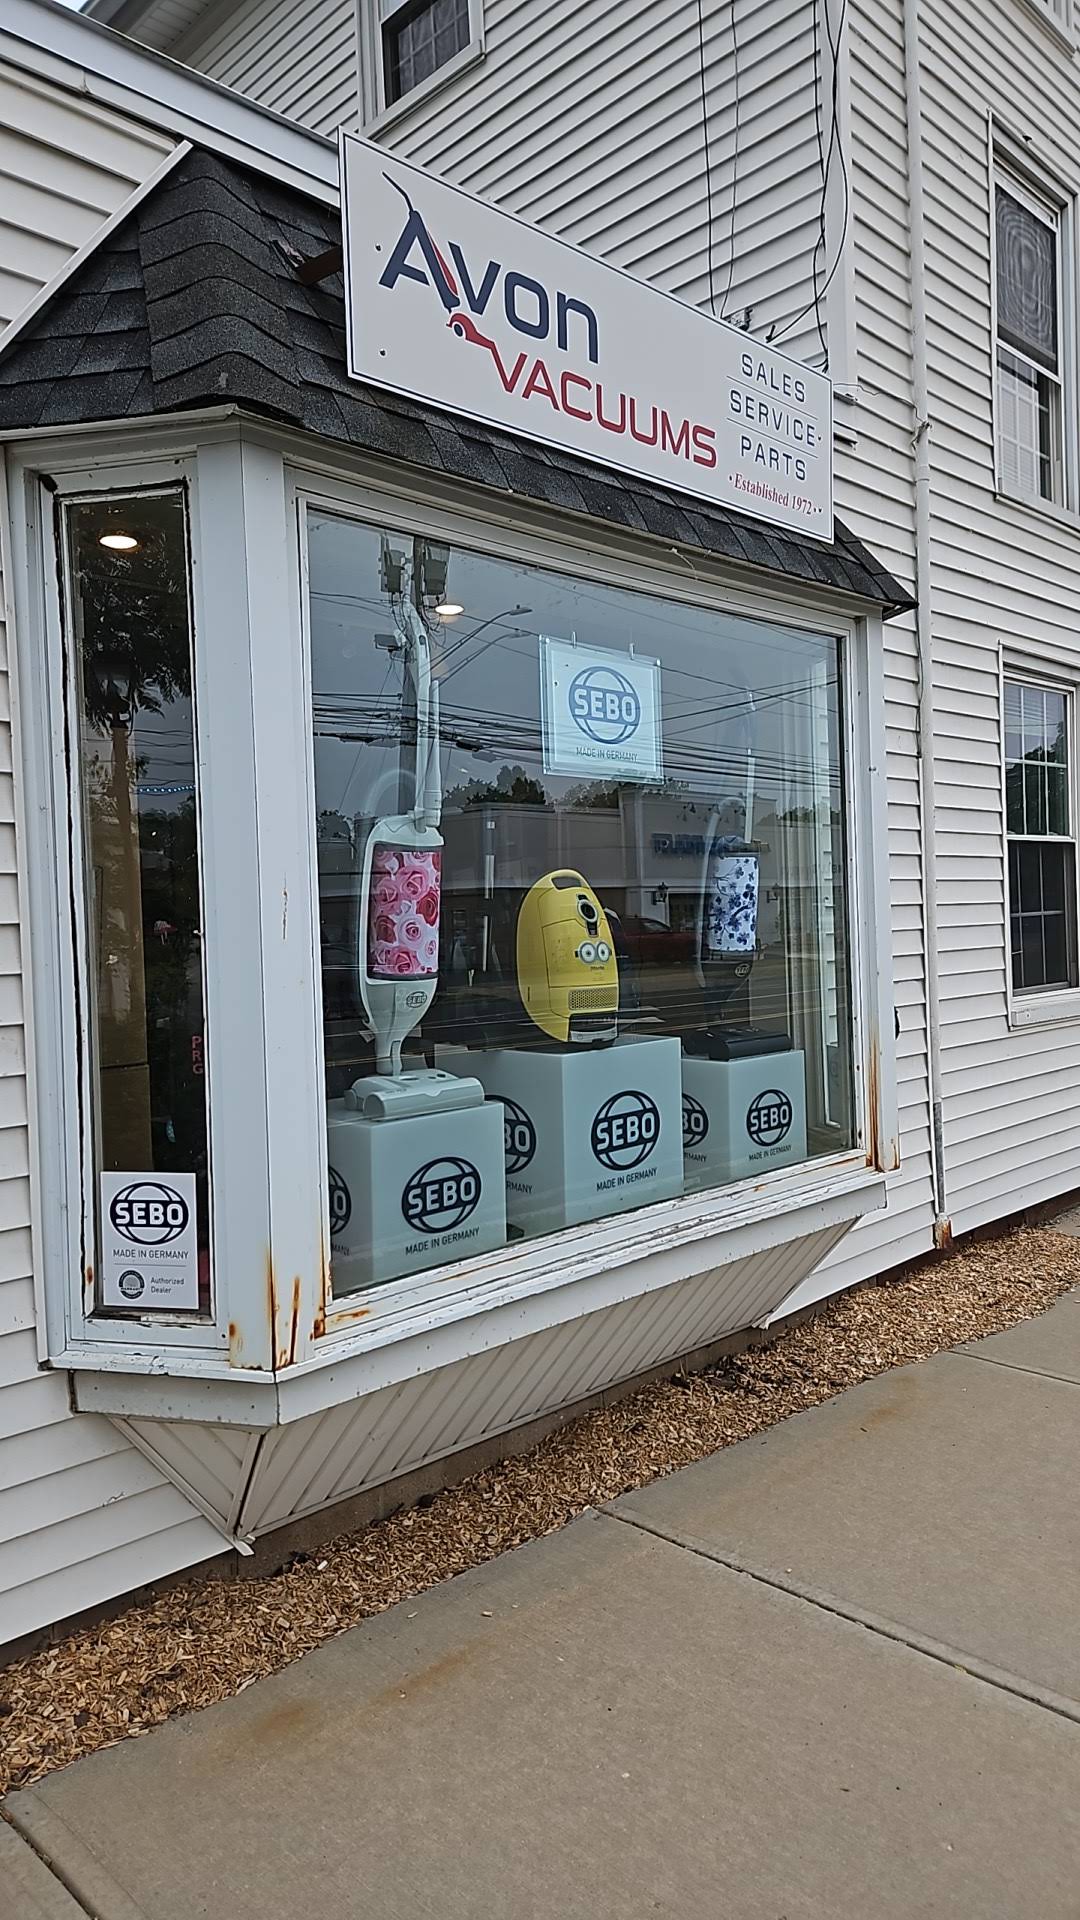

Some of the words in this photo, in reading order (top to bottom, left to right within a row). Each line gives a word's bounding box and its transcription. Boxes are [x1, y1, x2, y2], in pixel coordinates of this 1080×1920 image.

[741, 353, 805, 403] SALES
[488, 342, 718, 469] VACUUMS
[730, 389, 816, 447] SERVICE
[740, 435, 806, 481] PARTS
[734, 473, 789, 507] Established
[791, 495, 812, 515] 1972
[574, 688, 636, 723] SEBO
[576, 746, 596, 757] MADE
[597, 749, 605, 759] IN
[606, 749, 638, 762] GERMANY
[596, 1112, 655, 1150] SEBO
[750, 1104, 790, 1132] SEBO
[749, 1151, 762, 1160] MADE
[597, 1177, 616, 1192] MADE
[617, 1175, 624, 1186] IN
[626, 1167, 657, 1184] GERMANY
[408, 1175, 476, 1217] SEBO
[115, 1202, 184, 1226] SEBO
[113, 1249, 136, 1258] MADE
[138, 1249, 147, 1258] IN
[148, 1249, 189, 1260] GERMANY
[405, 1240, 429, 1256] MADE
[431, 1237, 440, 1249] IN
[442, 1226, 480, 1246] GERMANY
[150, 1276, 185, 1285] Authorized
[150, 1286, 172, 1294] Dealer
